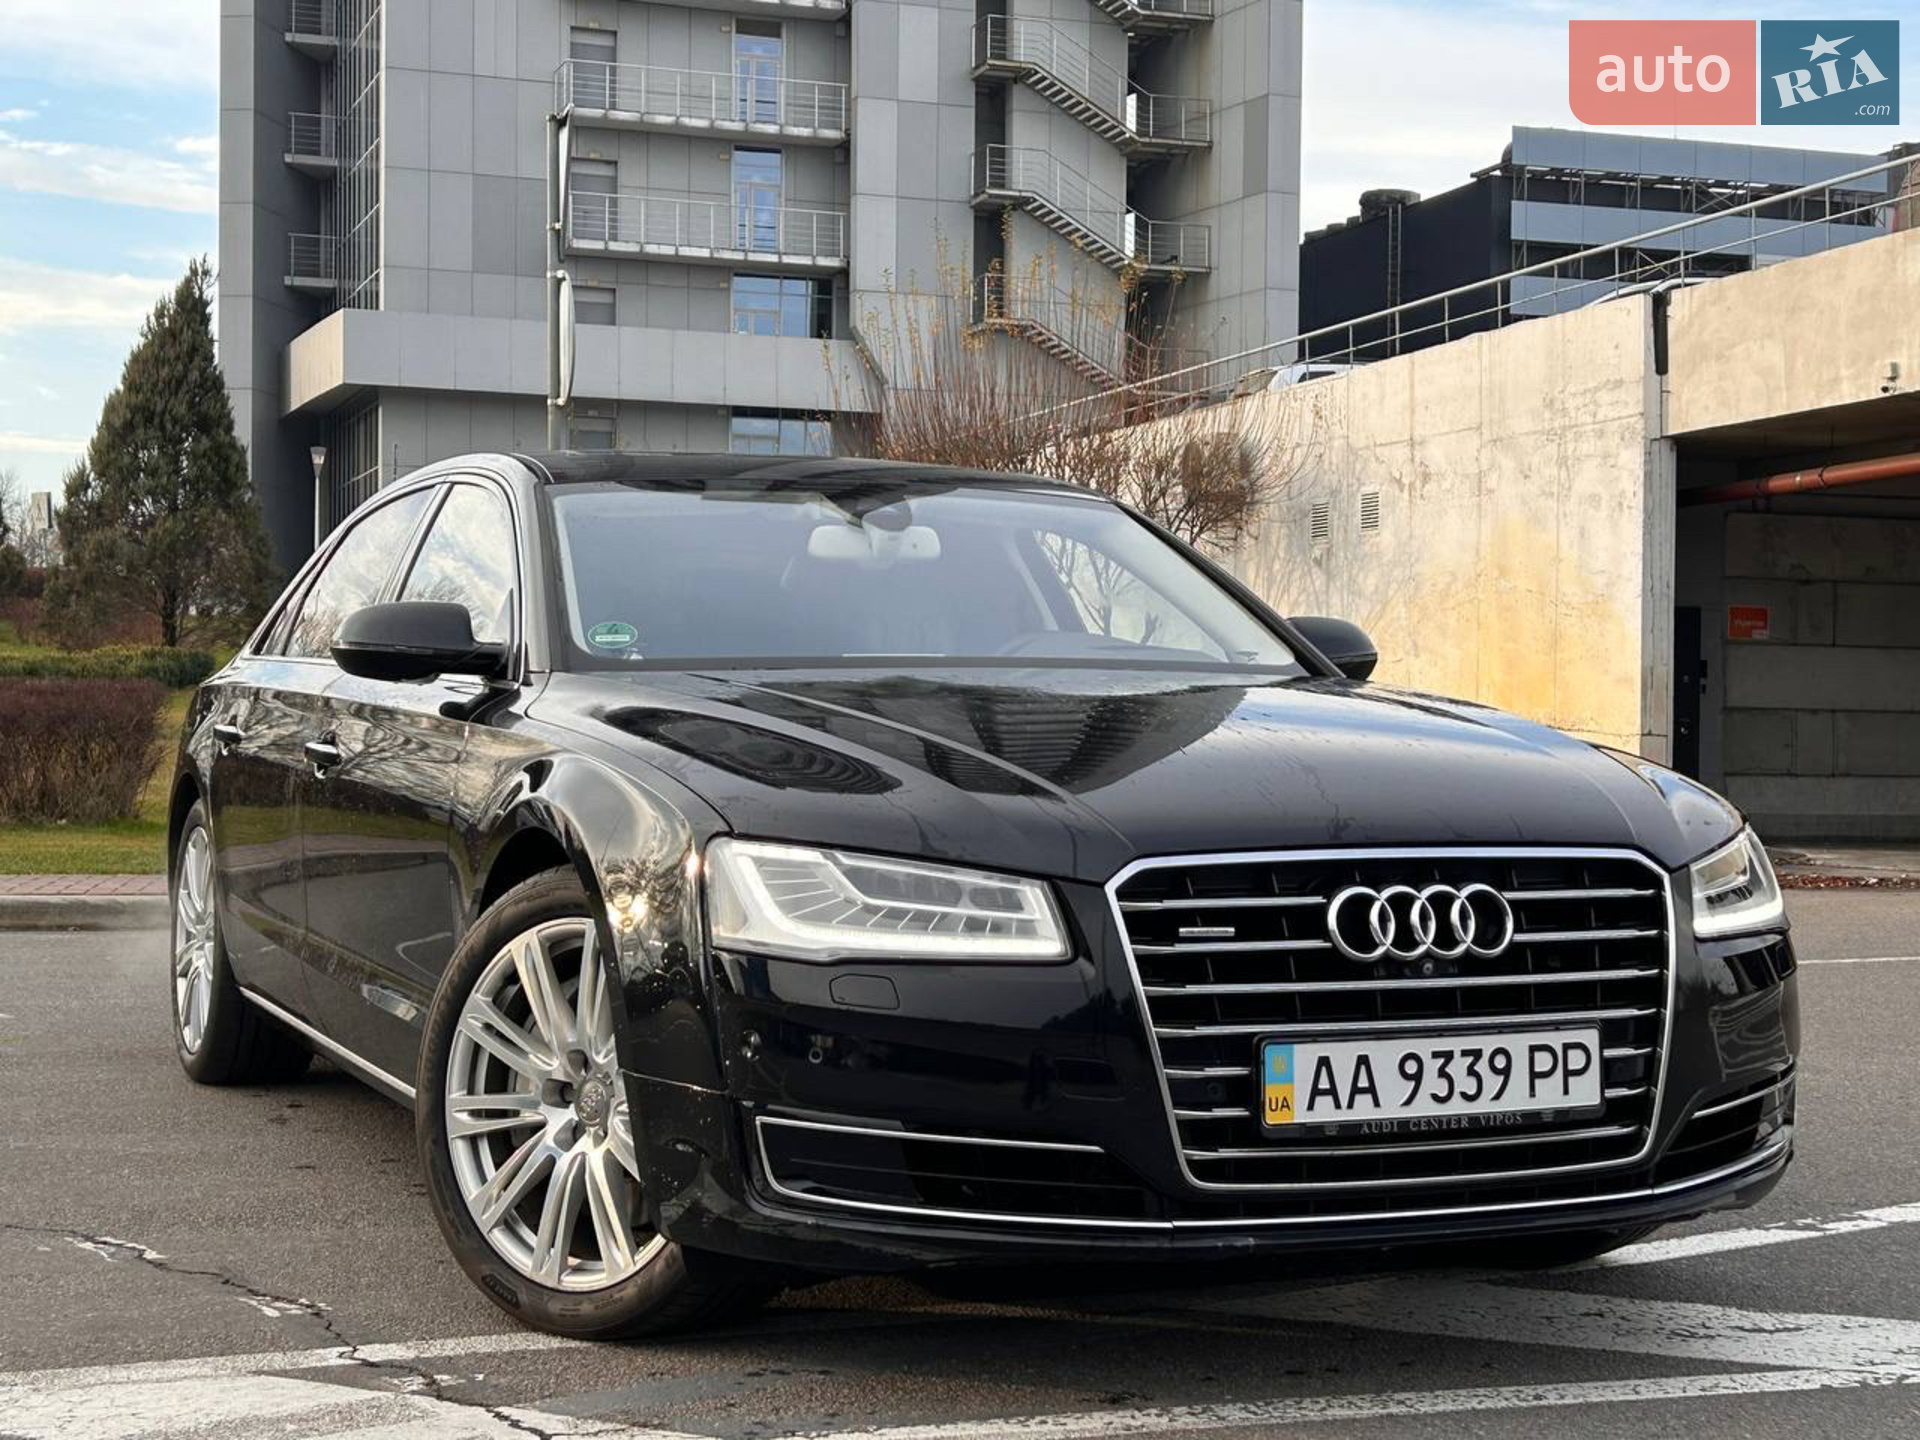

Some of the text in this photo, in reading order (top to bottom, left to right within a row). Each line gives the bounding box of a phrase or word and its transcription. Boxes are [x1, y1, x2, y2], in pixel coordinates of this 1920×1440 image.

[1306, 1042, 1592, 1111] AA 9339 PP
[1268, 1095, 1291, 1113] UA
[1360, 1112, 1523, 1134] AUDI CENTER VIPOS
